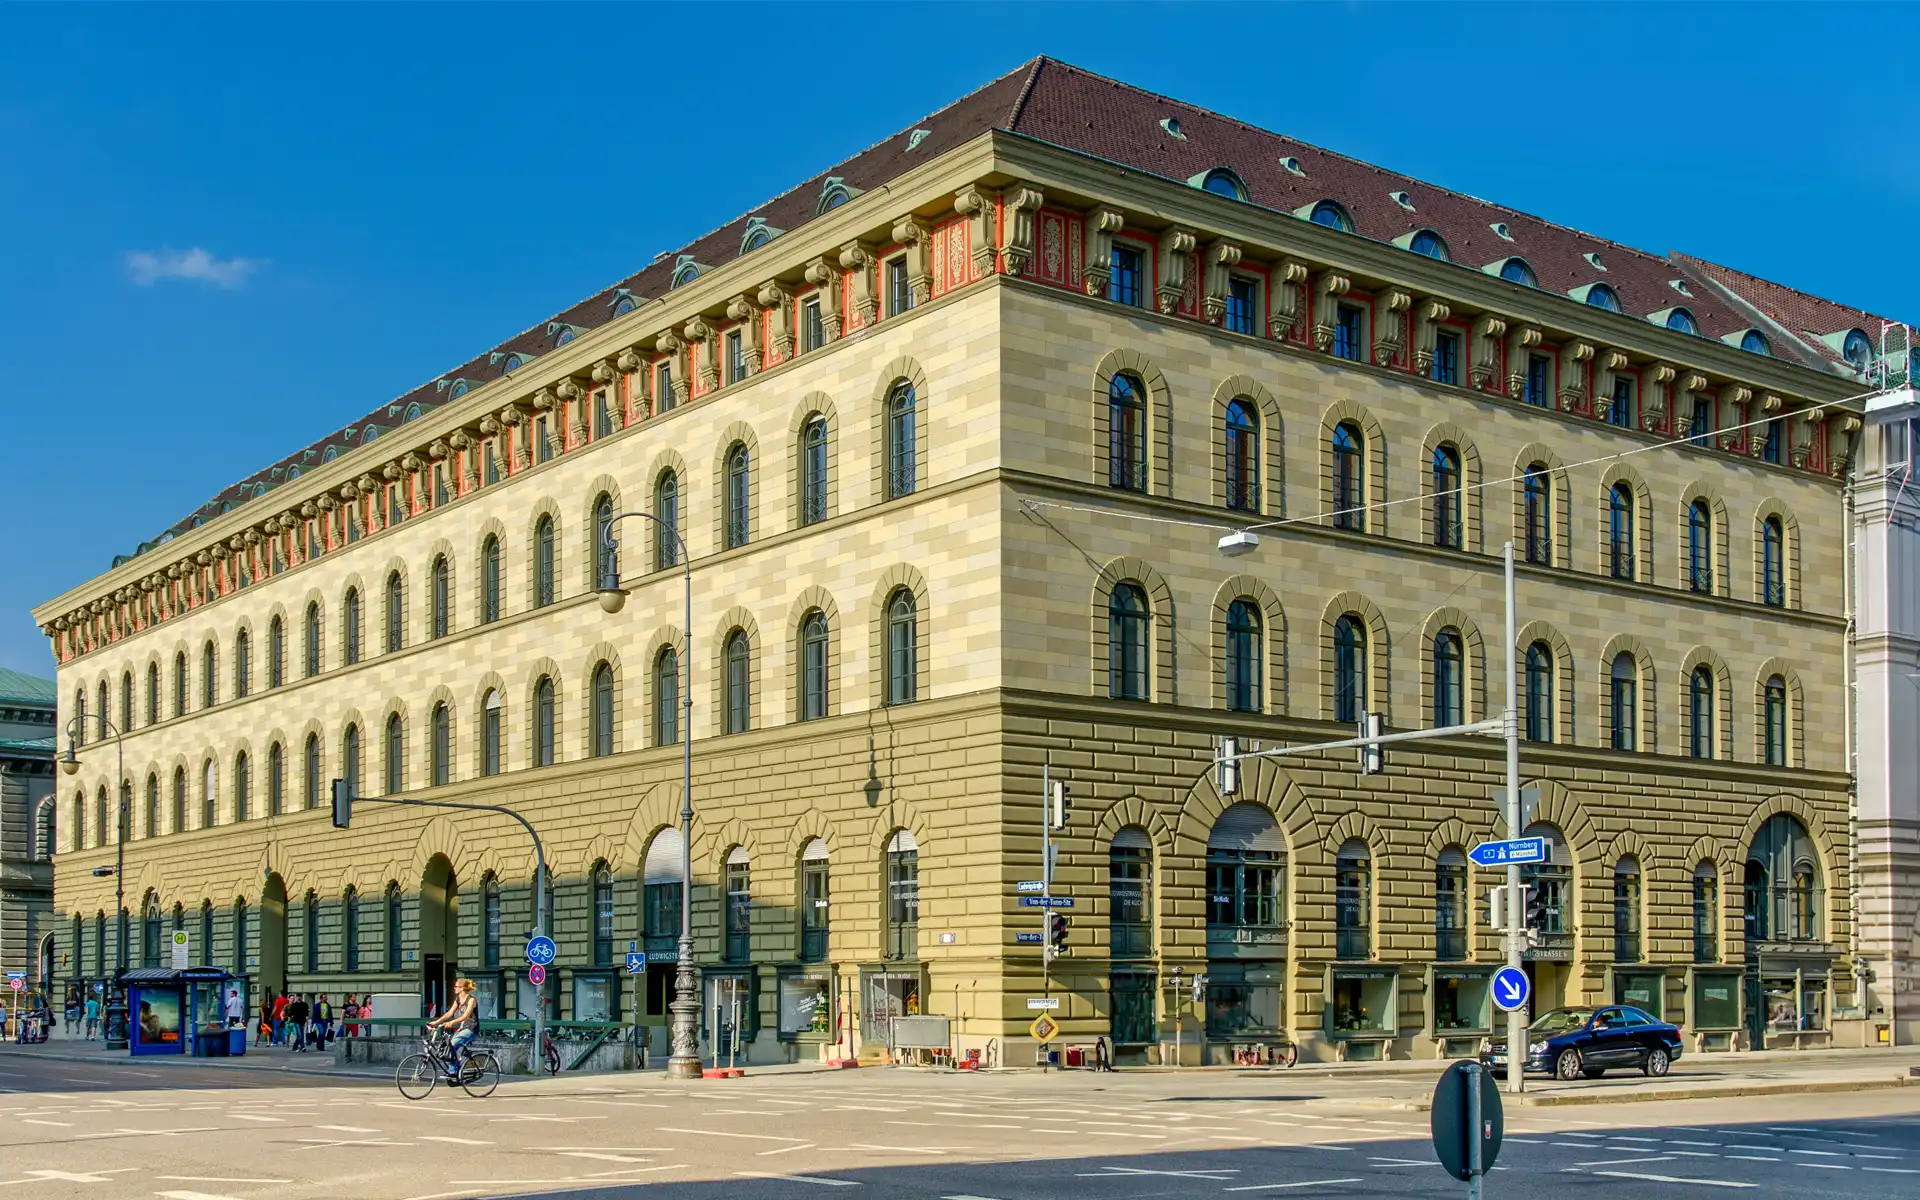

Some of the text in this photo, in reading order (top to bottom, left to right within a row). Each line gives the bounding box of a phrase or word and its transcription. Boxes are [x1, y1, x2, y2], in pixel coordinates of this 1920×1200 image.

[1509, 842, 1538, 850] Nürnberg
[1018, 932, 1043, 940] Von-der-T
[649, 952, 678, 960] LUDWIGSTR
